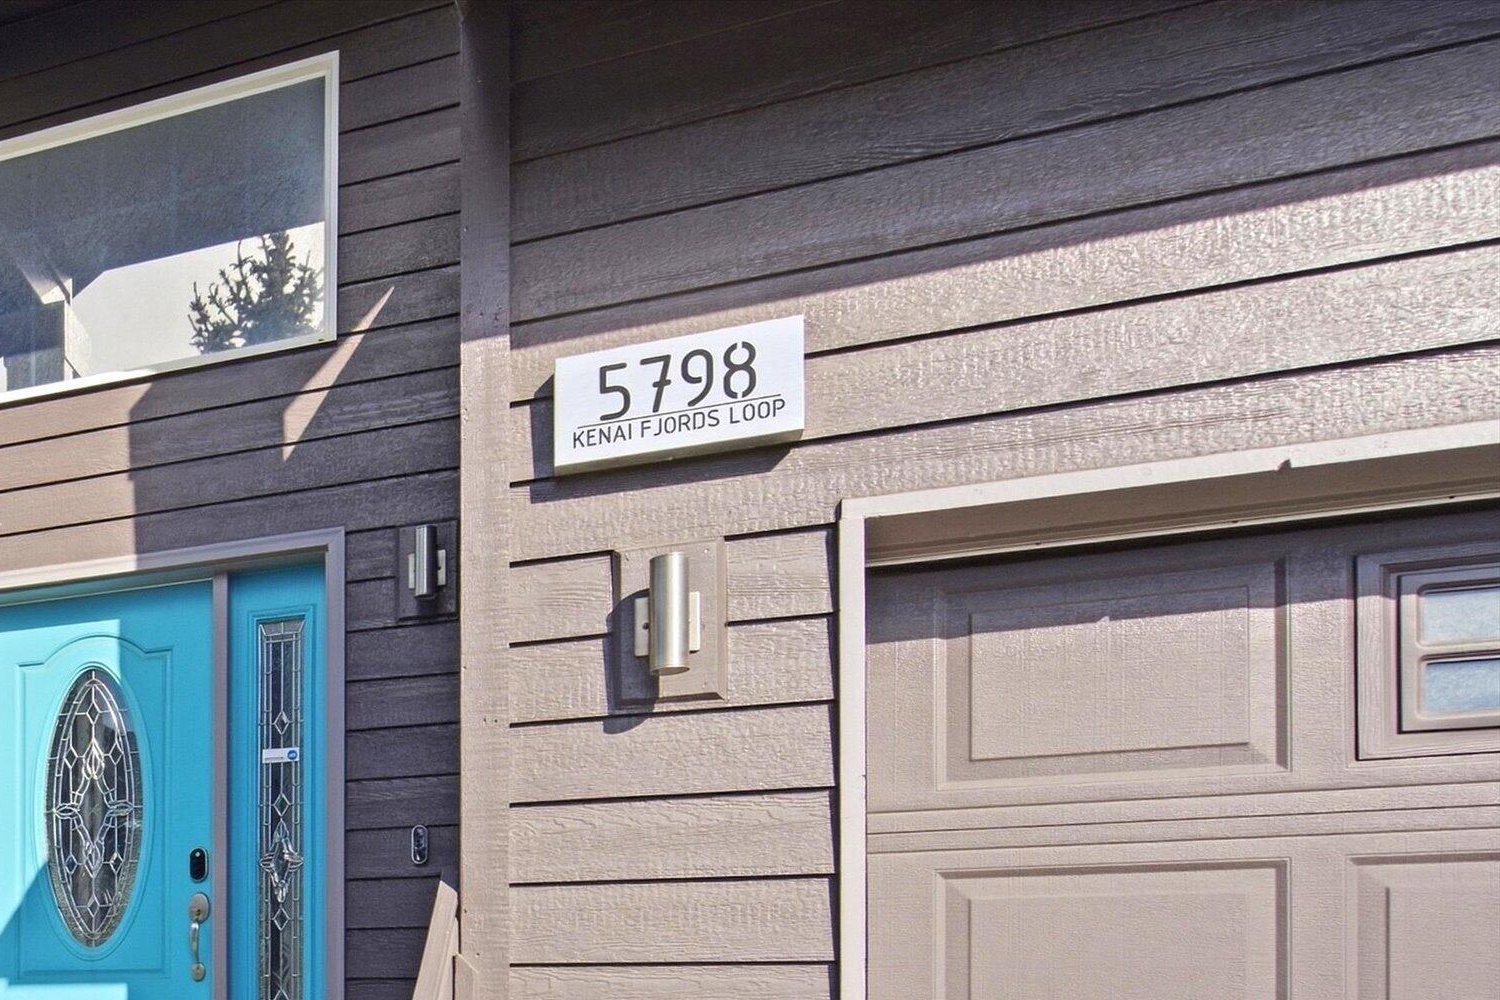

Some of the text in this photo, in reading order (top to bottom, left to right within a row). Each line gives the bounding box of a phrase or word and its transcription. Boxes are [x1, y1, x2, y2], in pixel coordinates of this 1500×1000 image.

[599, 341, 757, 421] 5798
[572, 398, 786, 449] KENAI FJORDS LOOP
